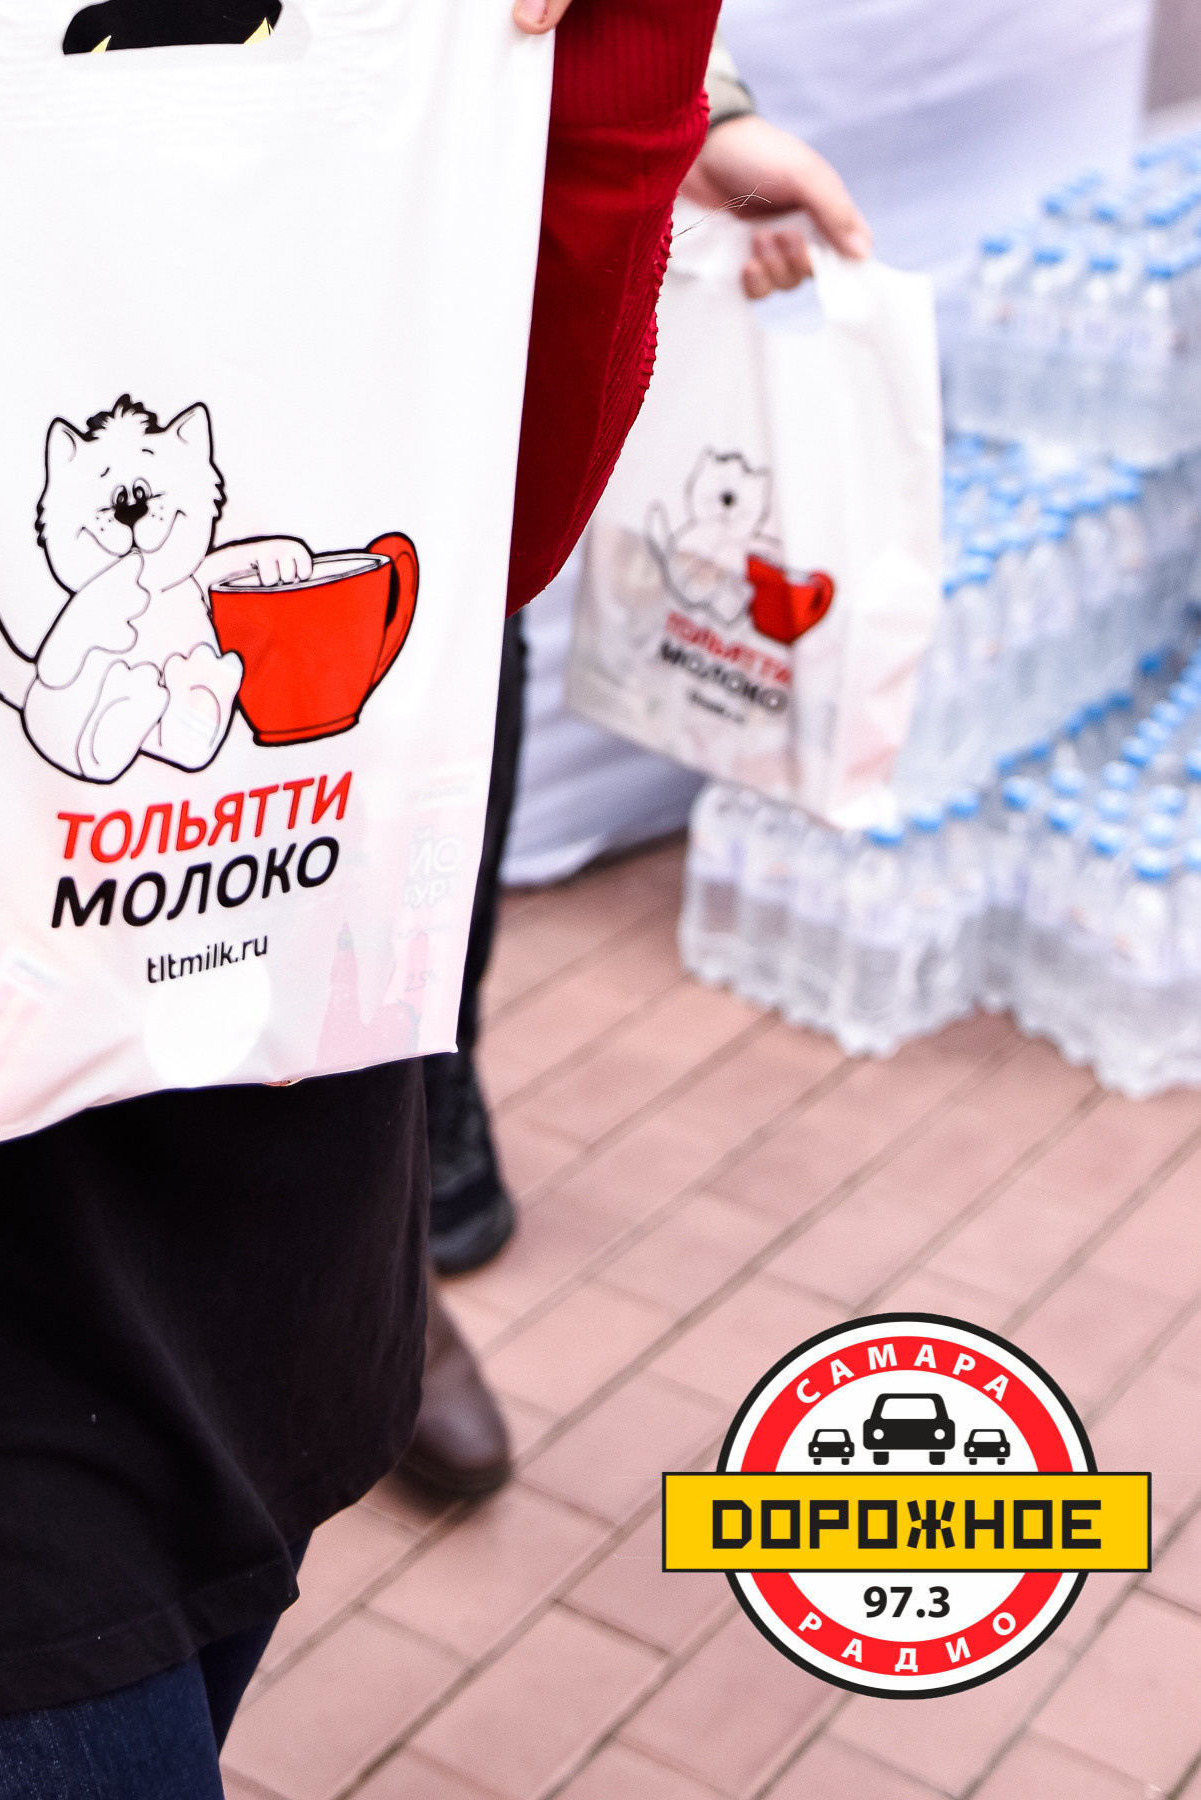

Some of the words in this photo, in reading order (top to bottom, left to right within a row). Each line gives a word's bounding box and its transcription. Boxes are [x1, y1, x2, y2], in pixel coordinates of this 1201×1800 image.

[56, 771, 353, 864] ТОЛЬЯТТИ
[51, 836, 340, 929] МОЛОКО
[147, 936, 268, 984] tltmilk.ru
